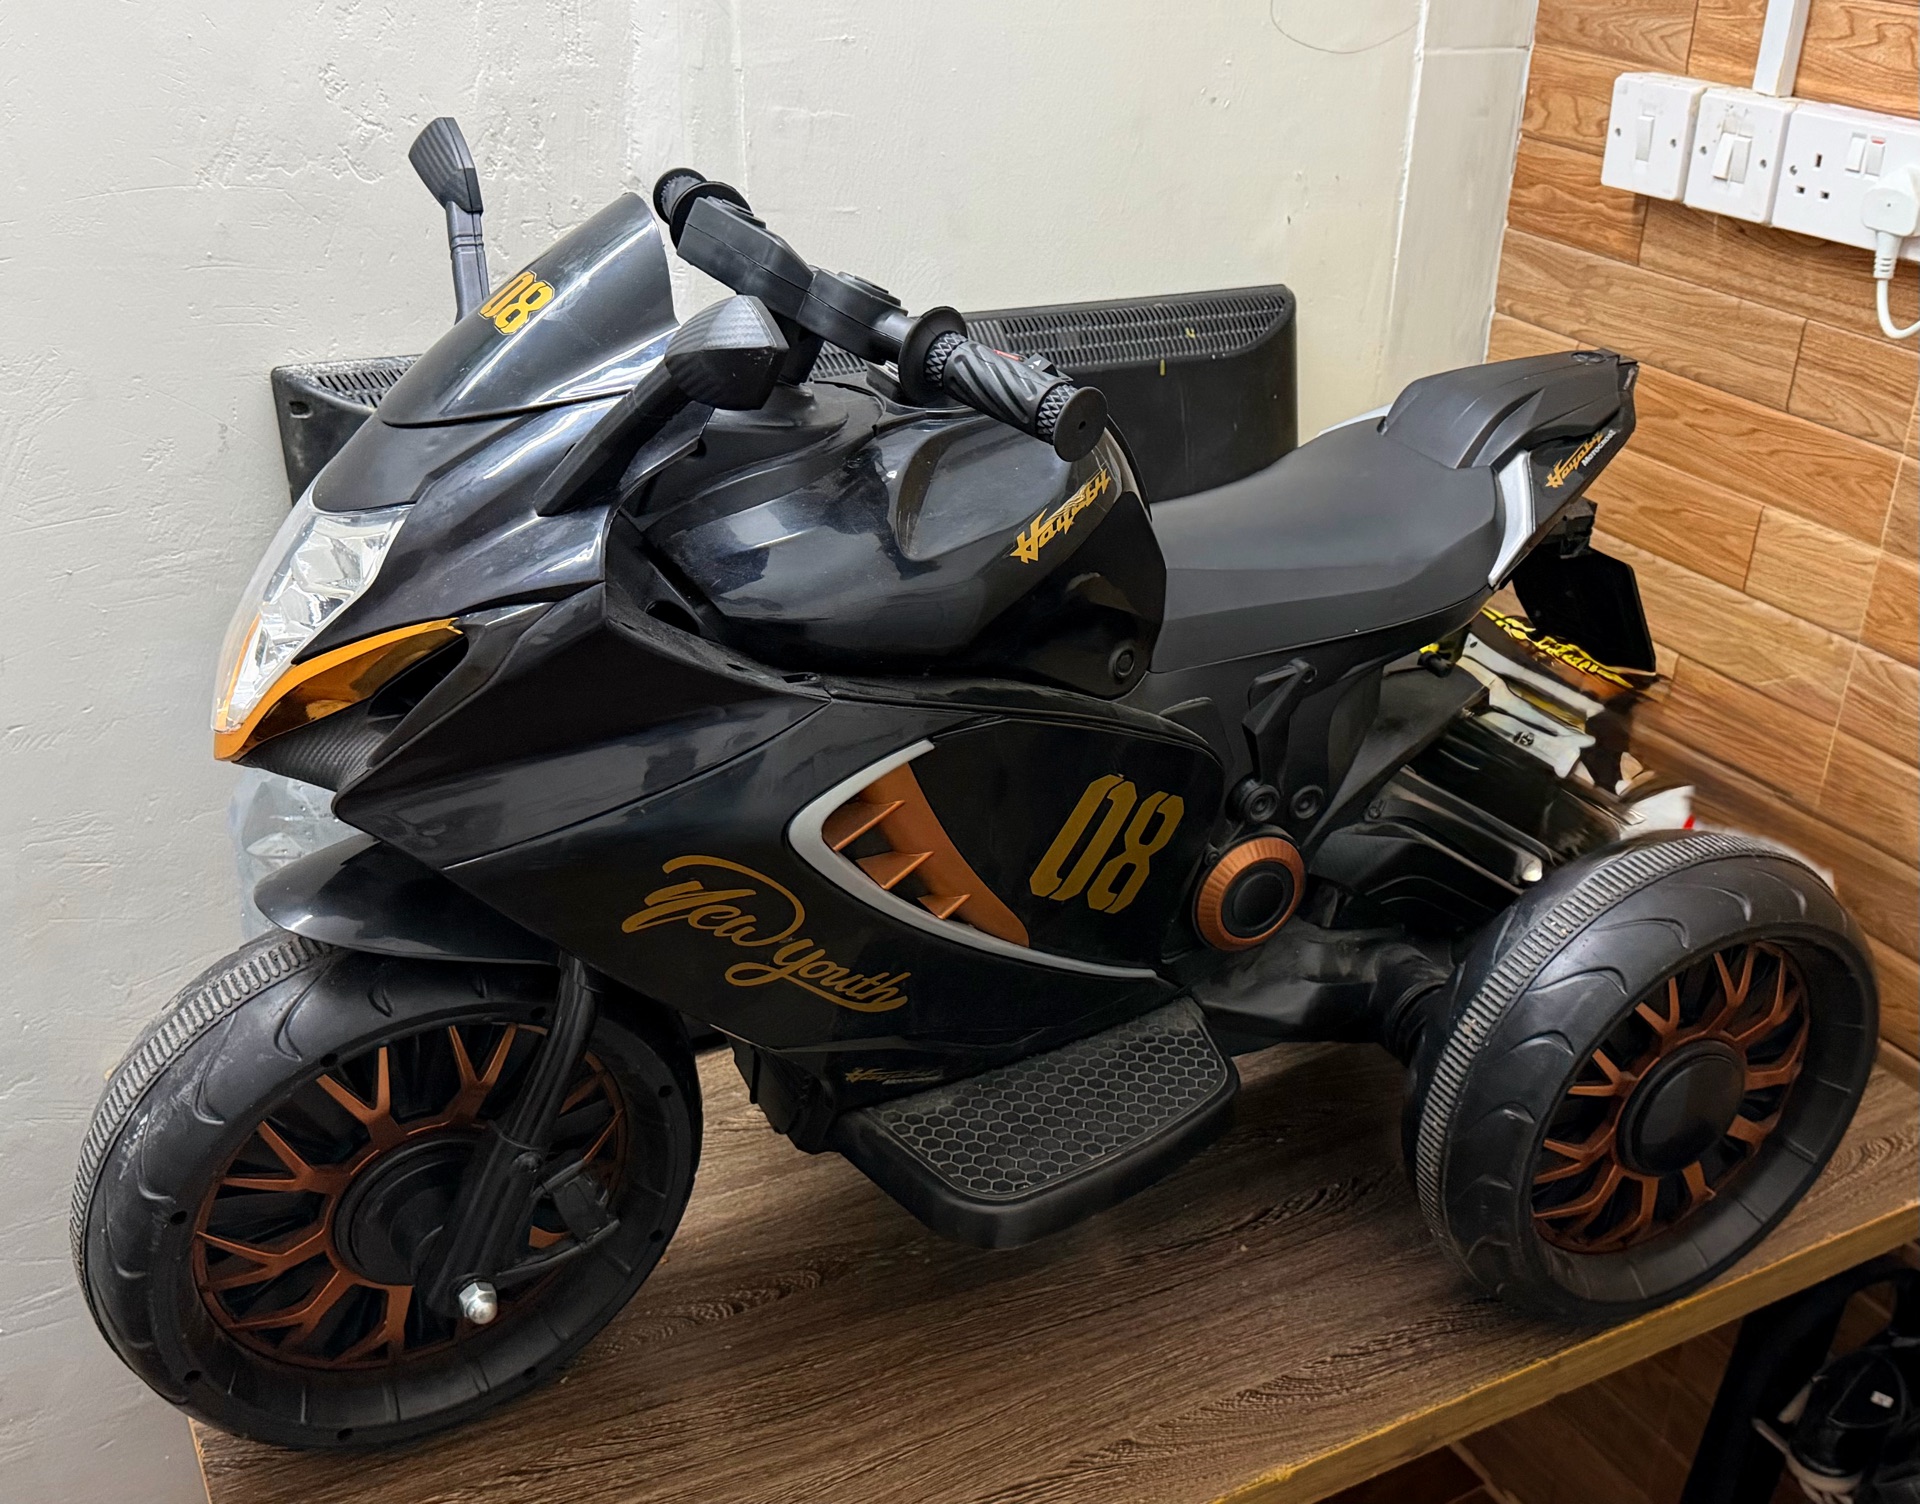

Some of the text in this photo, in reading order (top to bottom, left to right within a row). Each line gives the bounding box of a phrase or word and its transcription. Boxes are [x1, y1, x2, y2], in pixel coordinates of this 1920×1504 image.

[479, 271, 555, 334] 08
[1029, 773, 1185, 915] 08
[724, 938, 912, 1013] youth
